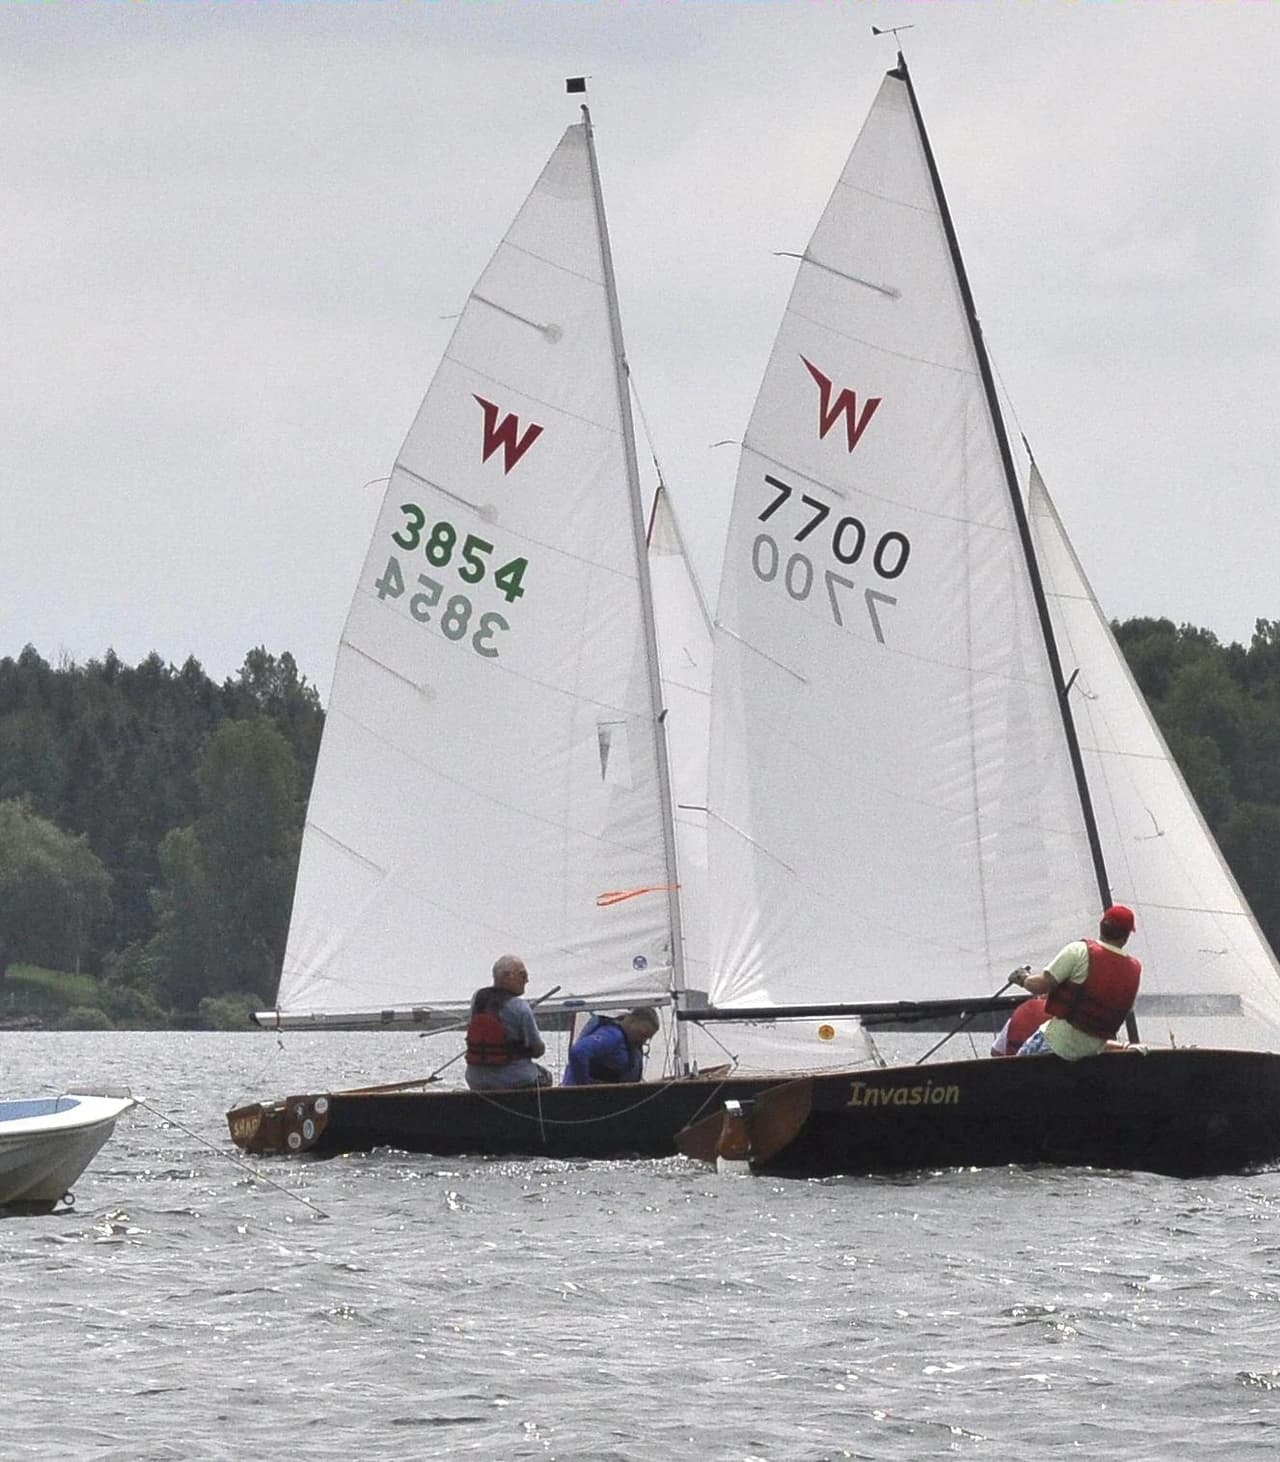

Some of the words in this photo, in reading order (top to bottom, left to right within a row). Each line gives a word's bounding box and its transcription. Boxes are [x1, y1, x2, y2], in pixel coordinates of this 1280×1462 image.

[473, 394, 544, 475] W
[801, 355, 883, 453] W
[391, 503, 529, 603] 3854
[757, 475, 910, 579] 7700
[847, 1080, 960, 1106] Invasion
